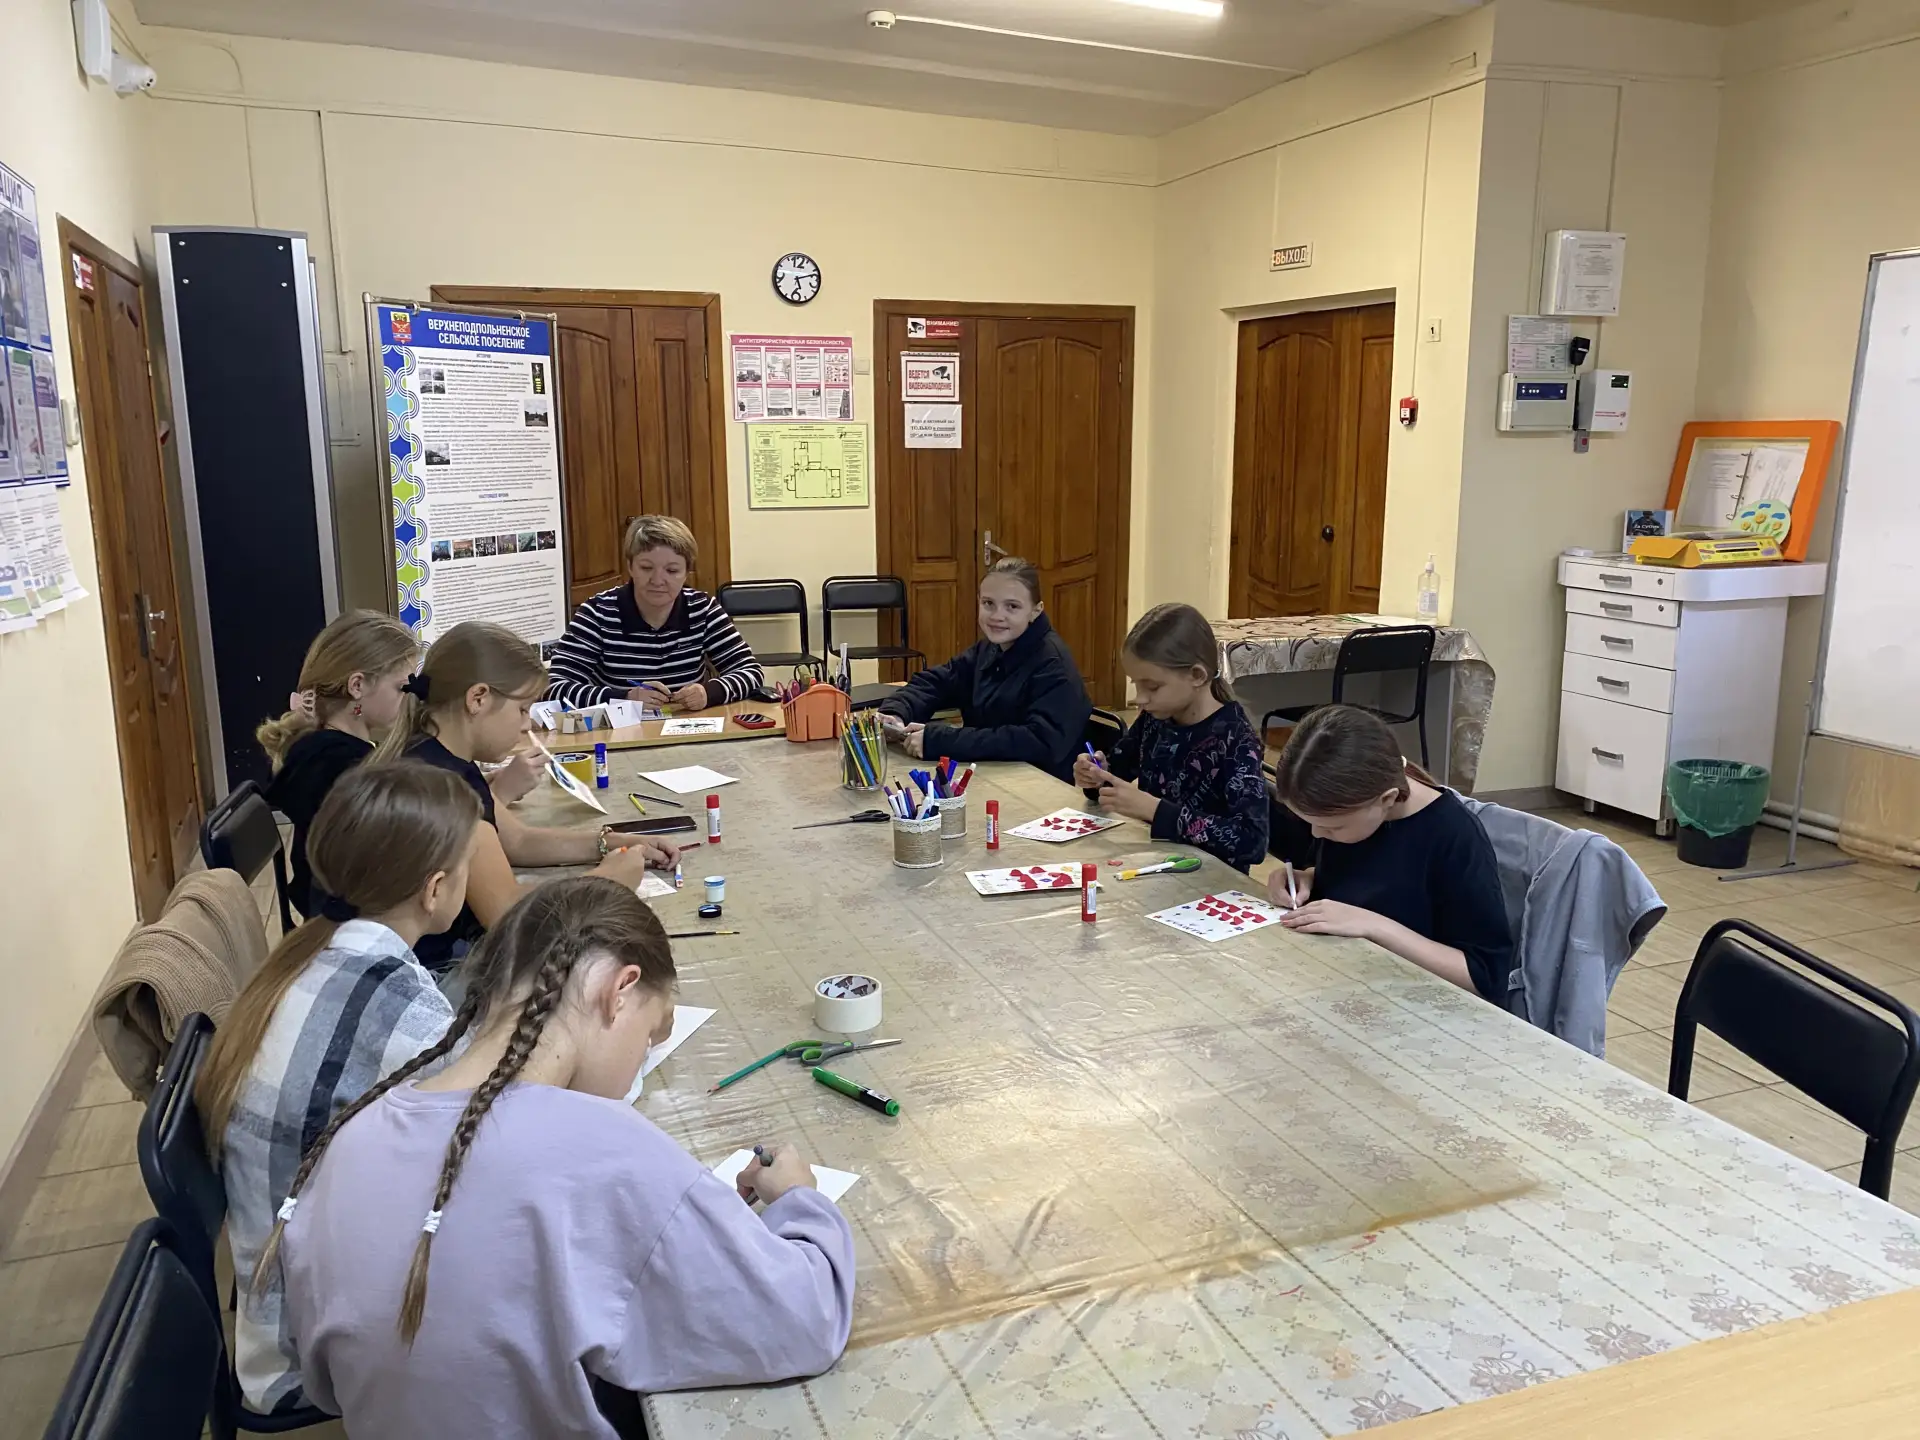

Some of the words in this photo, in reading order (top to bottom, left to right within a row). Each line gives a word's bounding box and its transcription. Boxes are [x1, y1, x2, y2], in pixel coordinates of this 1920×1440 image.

[791, 256, 805, 269] 12
[1275, 247, 1307, 265] ВЫХОД
[791, 288, 801, 300] 6
[428, 318, 530, 338] ВЕРХНЕПОДПОЛЬНЕНСКОЕ
[438, 332, 480, 346] СЕЛЬСКОЕ
[481, 335, 526, 349] ПОСЕЛЕНИЕ
